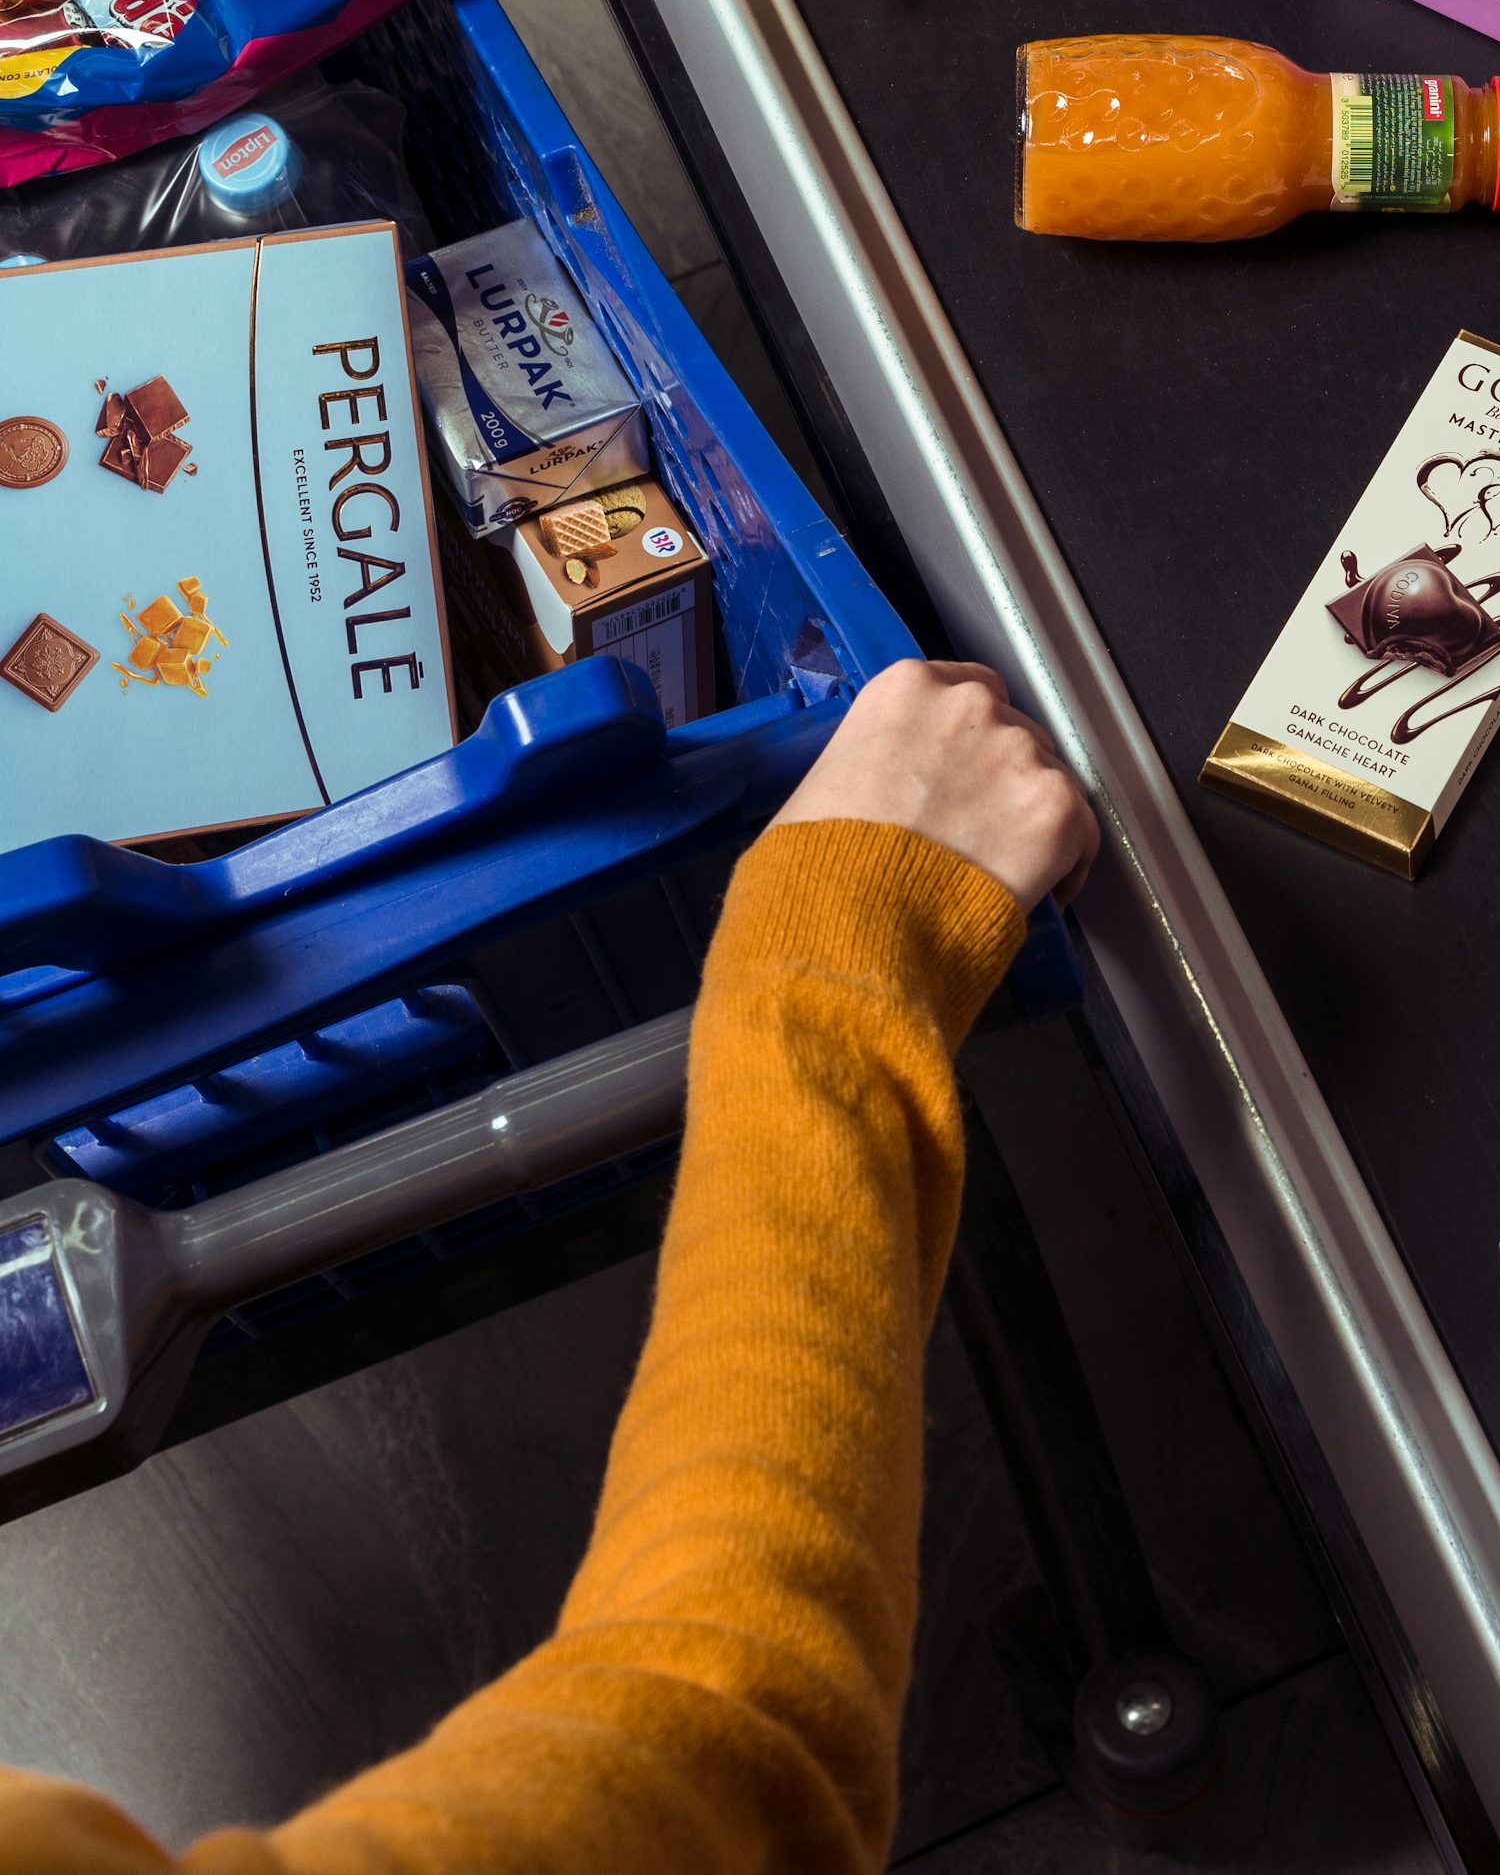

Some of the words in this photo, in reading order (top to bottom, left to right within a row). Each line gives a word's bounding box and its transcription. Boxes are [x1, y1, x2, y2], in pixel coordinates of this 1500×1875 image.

[1424, 78, 1443, 117] granini
[1341, 109, 1350, 142] 503789
[220, 130, 271, 172] Lipton
[465, 263, 570, 411] LURPAK
[472, 317, 511, 371] BUTTER
[480, 410, 510, 449] 200g
[529, 441, 600, 476] LURPAK
[292, 449, 313, 524] EXCELLENT
[303, 528, 318, 571] SINCE
[308, 573, 322, 603] 1952
[1285, 722, 1352, 761] GANACHE
[1350, 753, 1399, 780] HEART
[1290, 703, 1327, 727] DARK
[1326, 719, 1412, 767] CHOCOLATE
[1250, 741, 1276, 761] DARK
[1275, 752, 1332, 786] CHOCOLATE
[1330, 776, 1359, 799] WITH
[1358, 790, 1400, 816] VELVETY
[1287, 772, 1321, 794] GANAJ
[1319, 787, 1356, 812] FILLING
